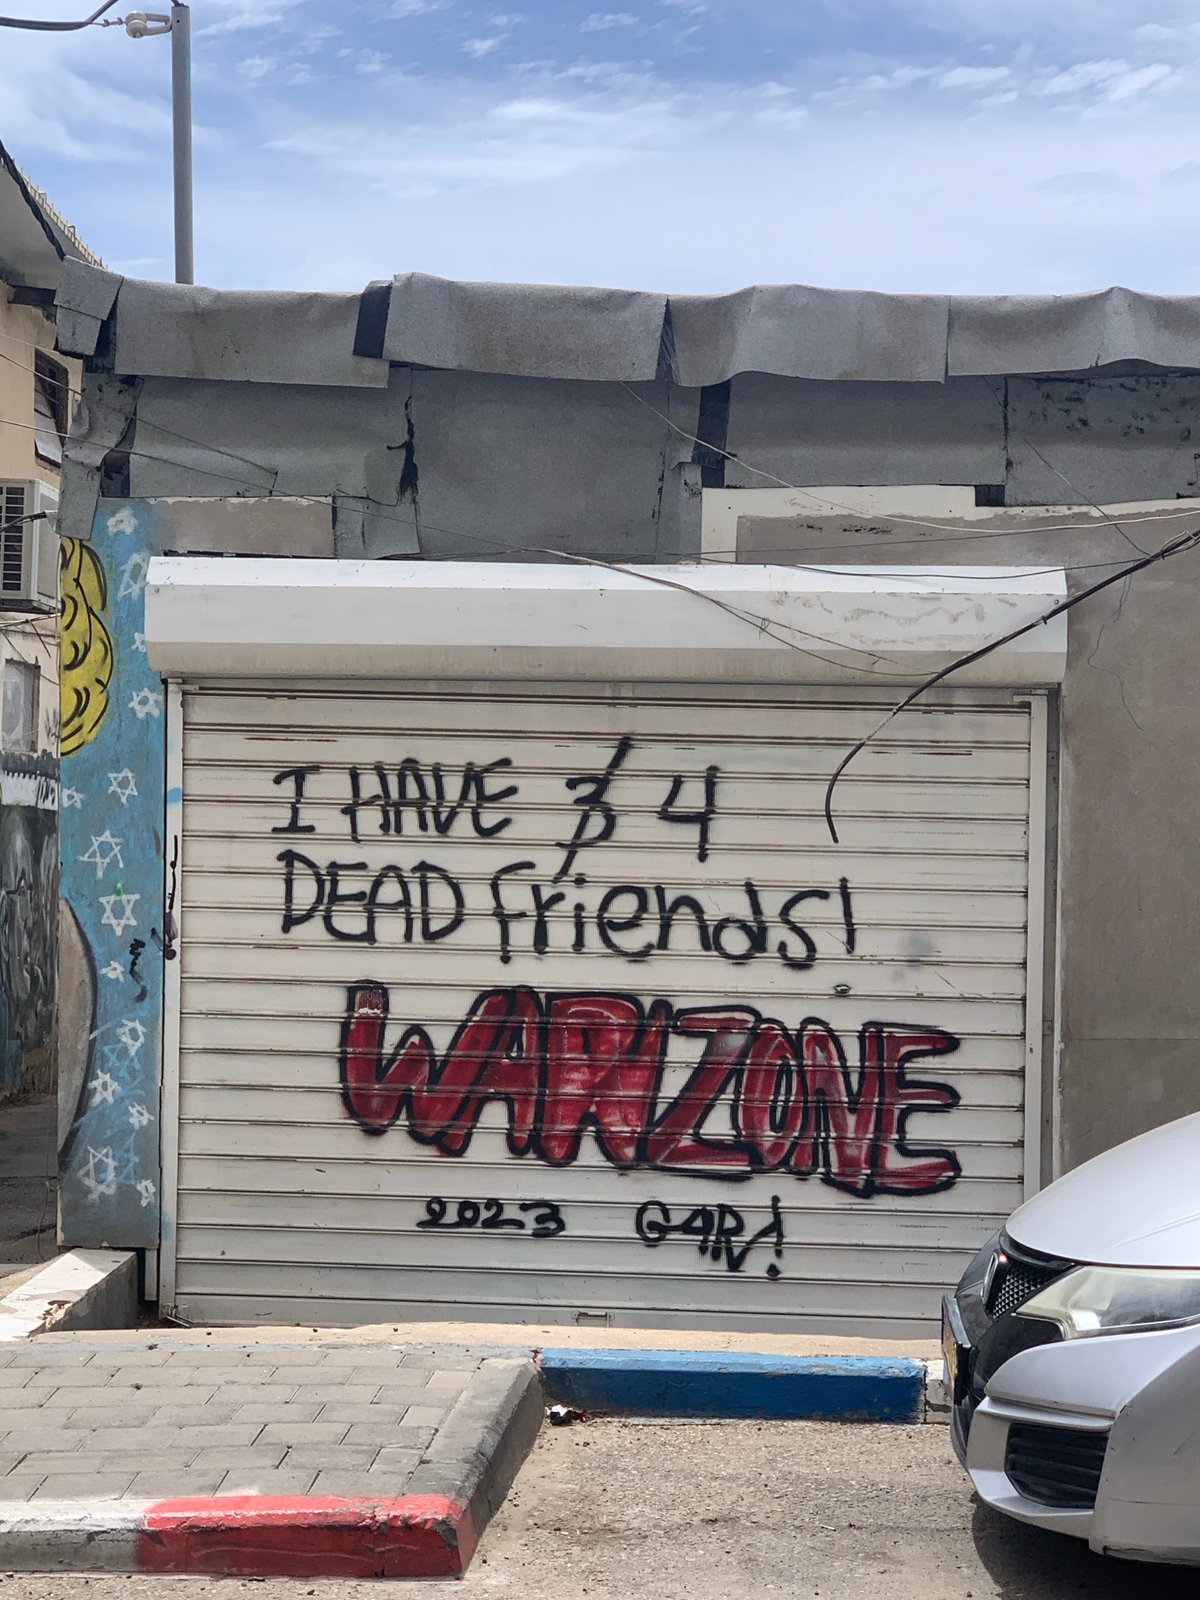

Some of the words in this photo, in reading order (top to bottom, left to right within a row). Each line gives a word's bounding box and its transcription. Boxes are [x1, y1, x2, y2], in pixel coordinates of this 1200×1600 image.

[272, 765, 320, 833] I
[341, 757, 519, 843] HAVE
[657, 765, 721, 863] 4
[277, 849, 466, 944] DEAD
[416, 1197, 566, 1238] 2023
